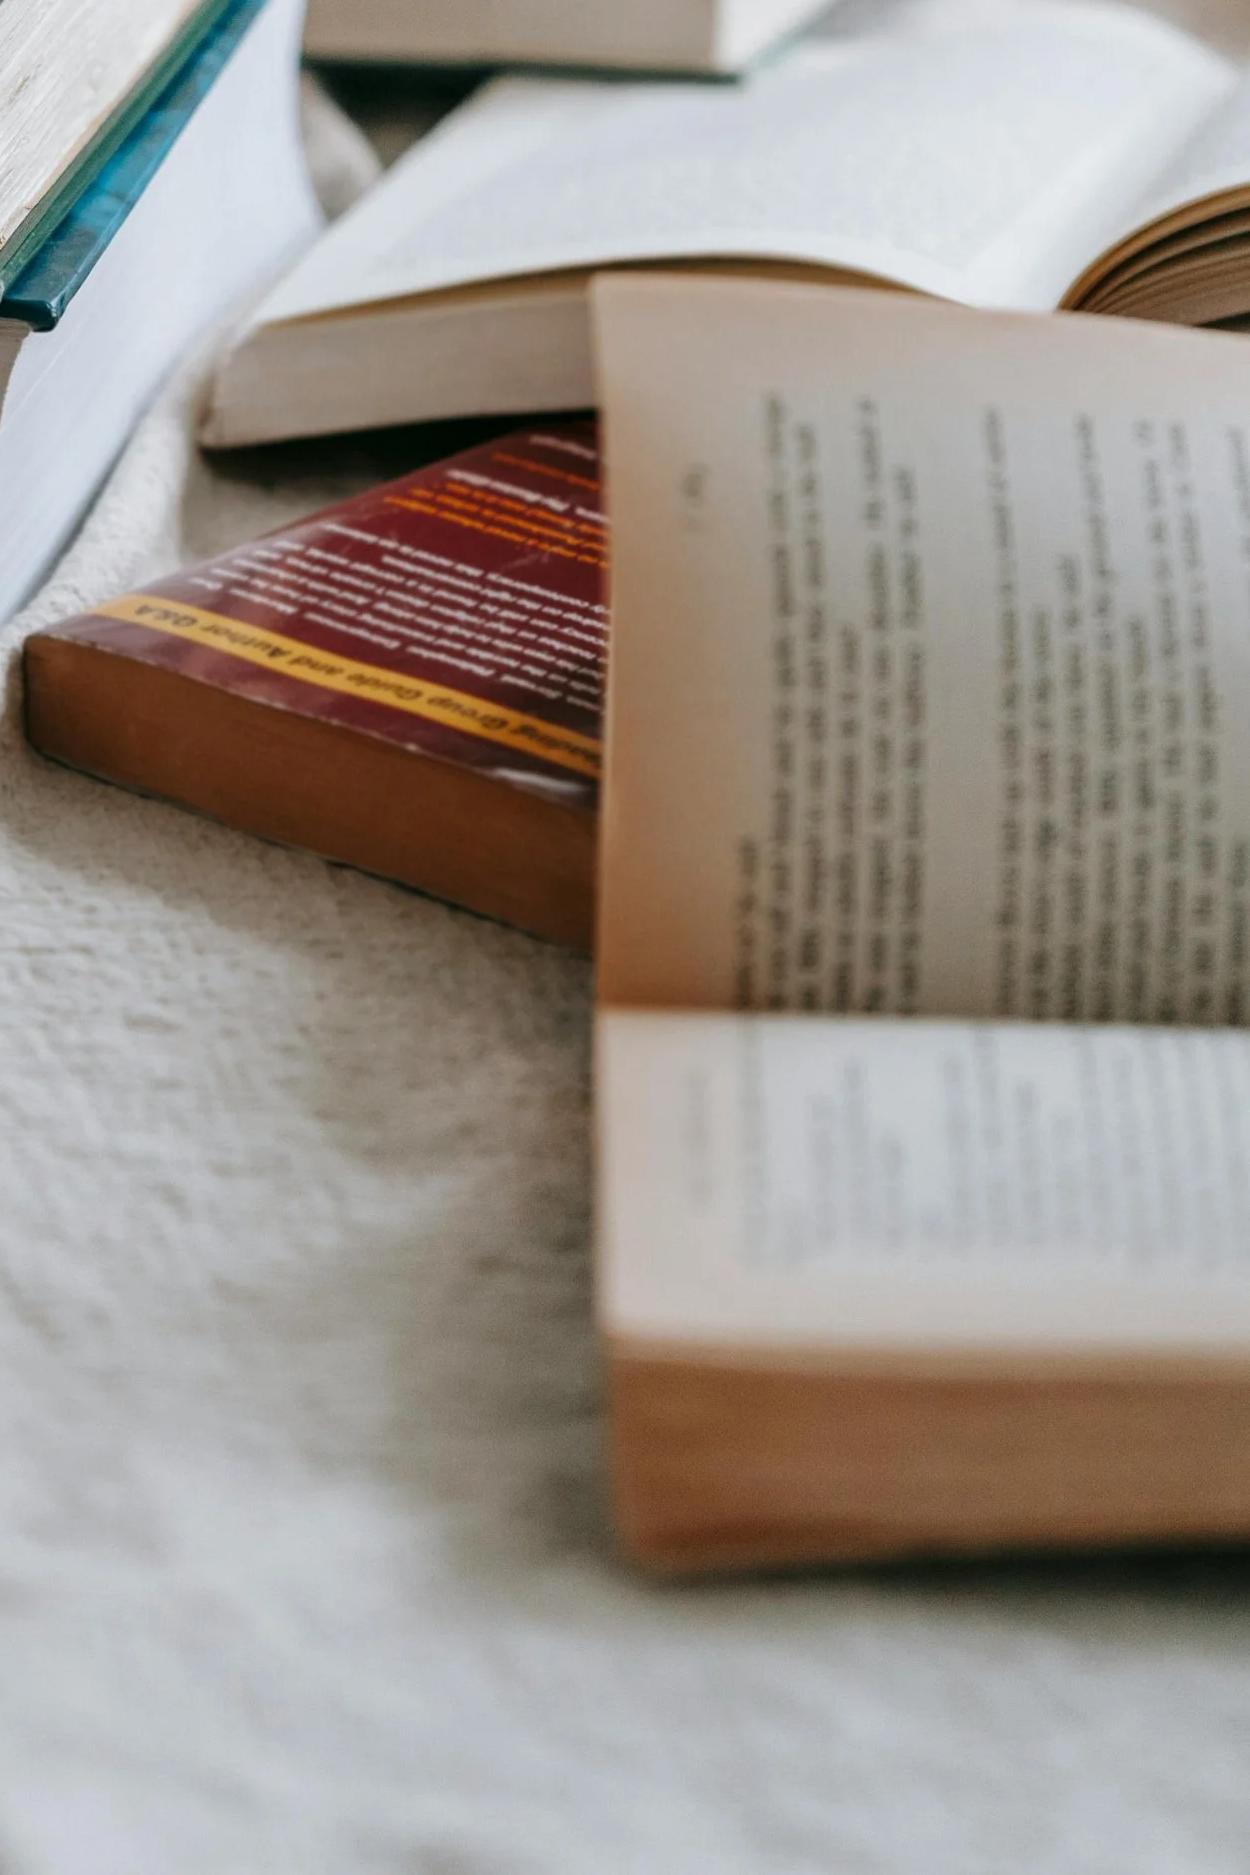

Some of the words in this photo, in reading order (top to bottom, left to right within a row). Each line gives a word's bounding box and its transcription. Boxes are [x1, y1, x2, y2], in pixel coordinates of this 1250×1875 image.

[135, 604, 198, 628] Q&A
[201, 624, 292, 659] Author
[287, 655, 346, 677] and
[347, 673, 424, 701] Guide
[427, 696, 508, 730] Group
[509, 723, 602, 766] eading
